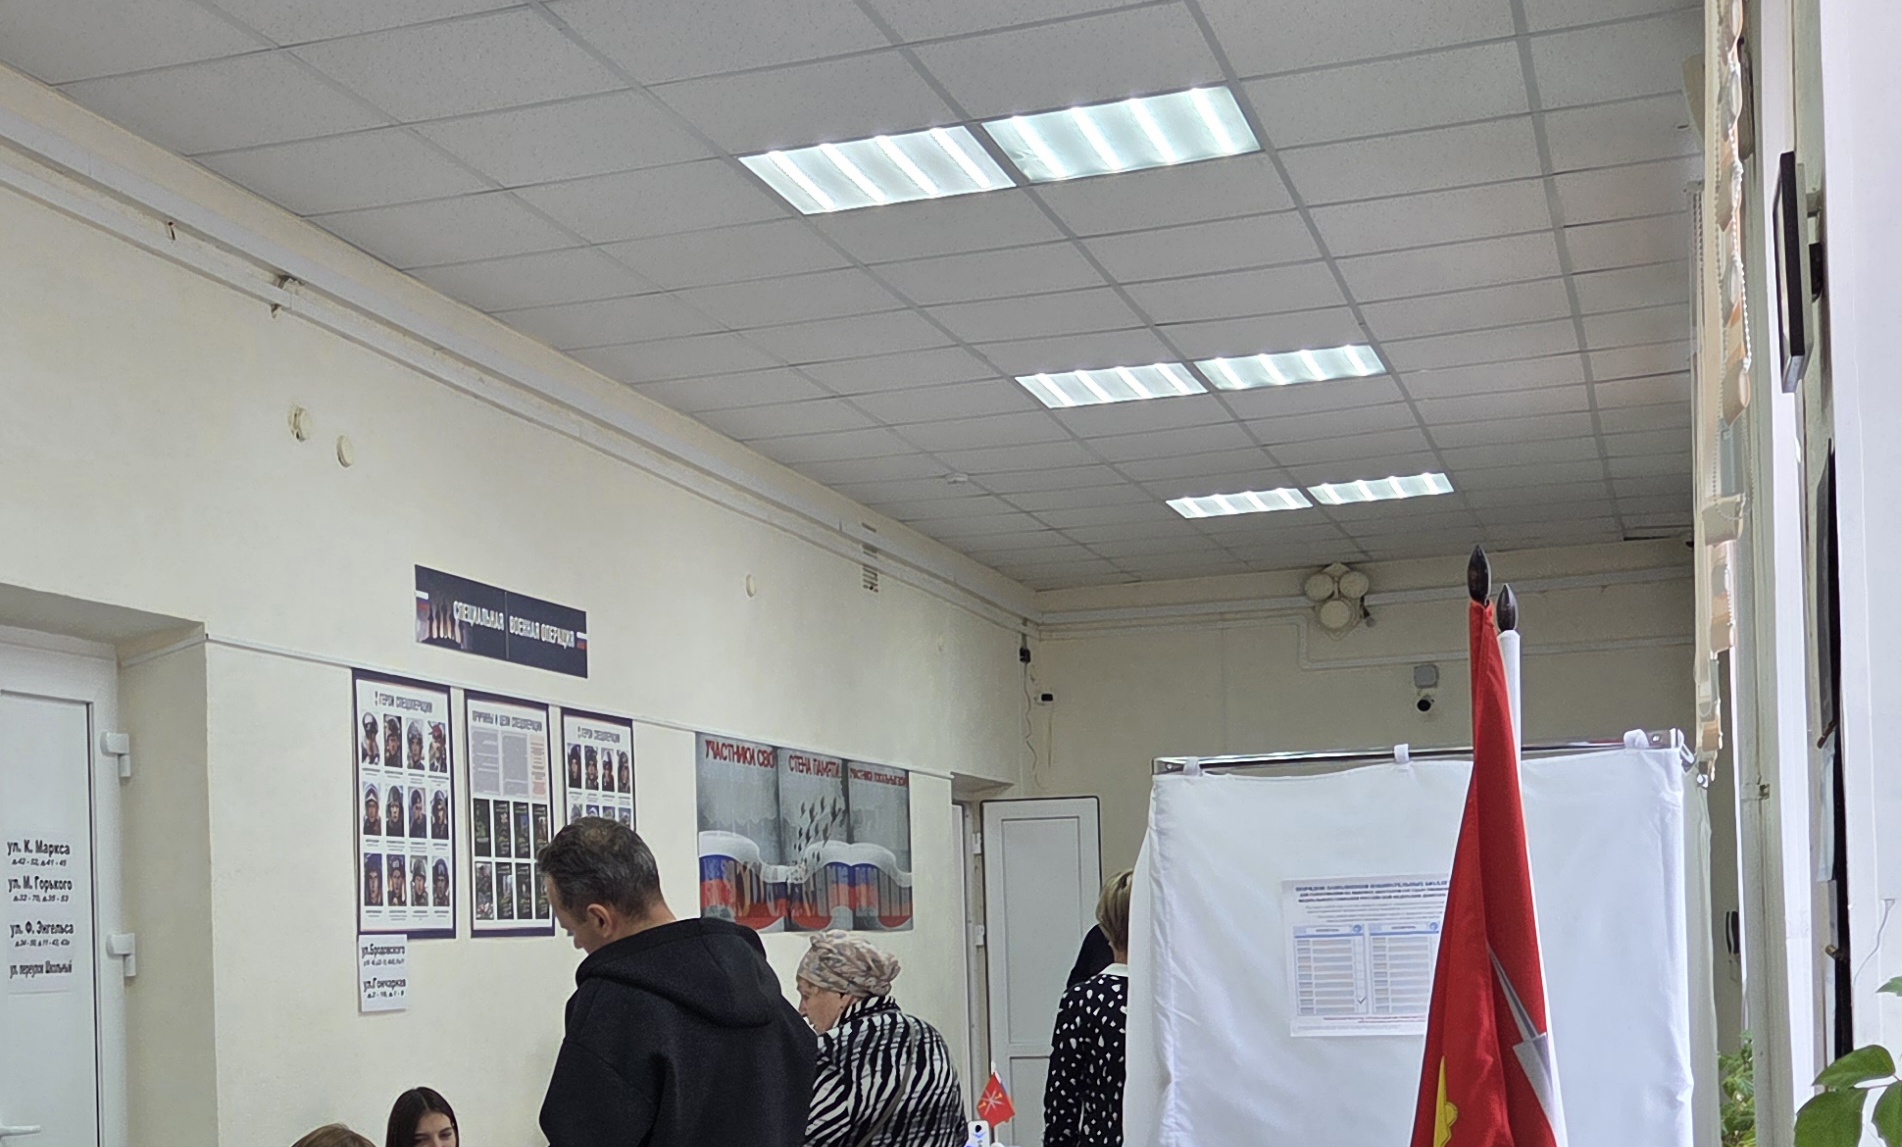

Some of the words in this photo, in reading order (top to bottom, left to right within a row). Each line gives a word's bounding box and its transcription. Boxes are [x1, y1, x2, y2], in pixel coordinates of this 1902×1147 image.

[453, 600, 505, 631] СПЕЦИАЛЬНАЯ
[509, 615, 540, 640] ВОЕННАЯ
[541, 623, 576, 649] ОПЕРАЦИЯ
[705, 740, 756, 766] УЧАСТНИКИ
[757, 749, 776, 769] СВО
[788, 754, 812, 775] СТЕНА
[812, 758, 842, 779] ПАМЯТИ
[7, 841, 22, 857] ул.
[23, 839, 34, 854] К.
[35, 839, 71, 858] Маркса
[8, 878, 22, 893] ул.
[23, 875, 33, 890] М.
[34, 875, 73, 894] Горького
[10, 924, 23, 939] ул.
[25, 920, 35, 934] Ф.
[36, 920, 74, 934] Энгельса
[19, 964, 44, 978] переулок
[45, 959, 73, 974] Школьный
